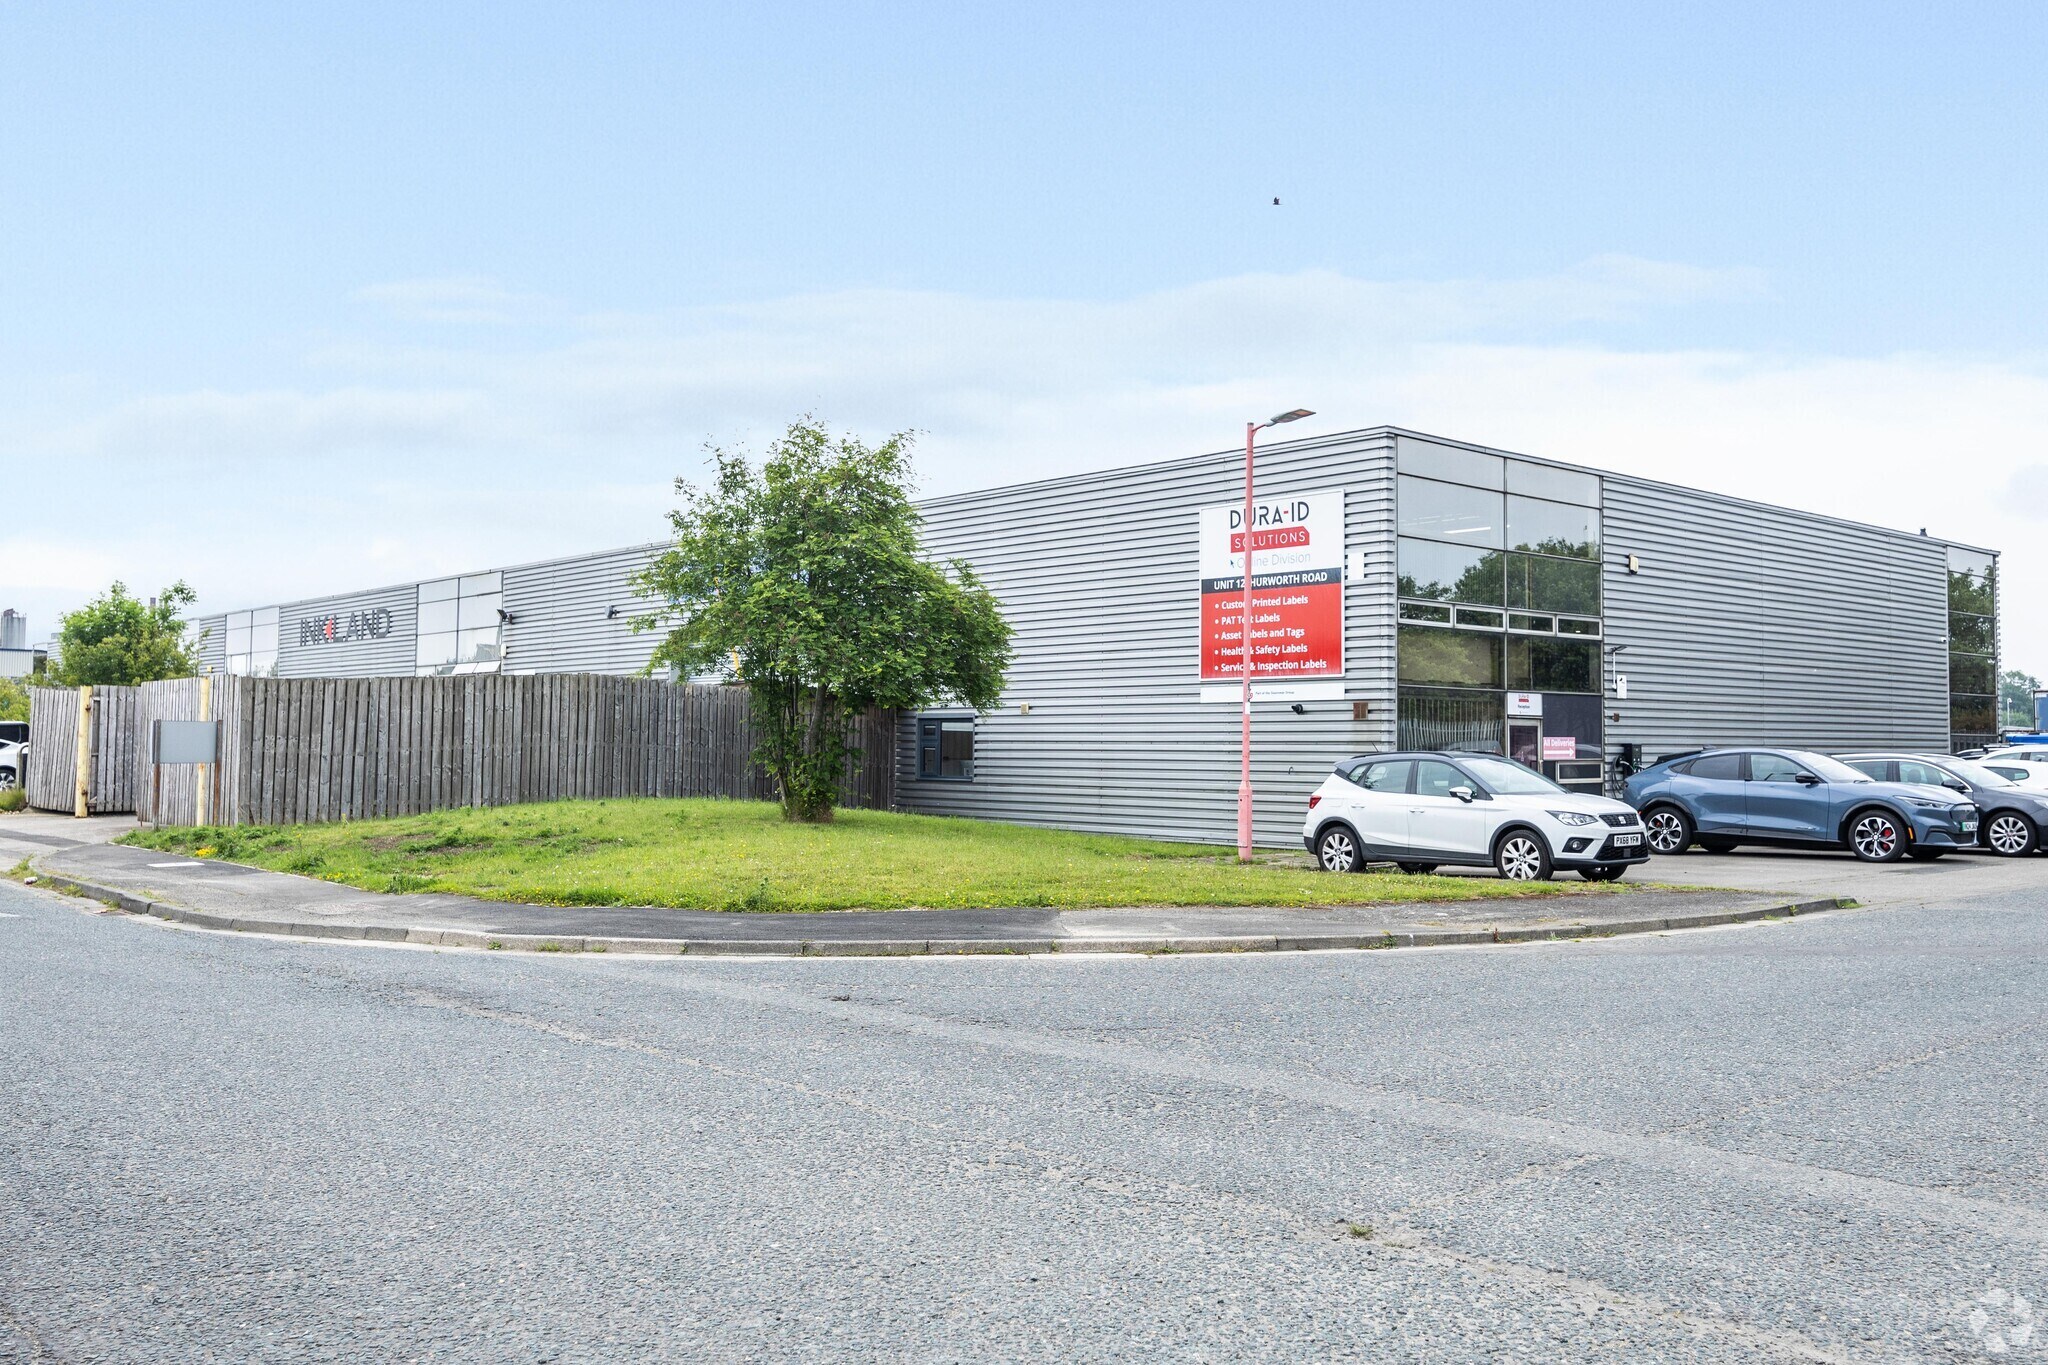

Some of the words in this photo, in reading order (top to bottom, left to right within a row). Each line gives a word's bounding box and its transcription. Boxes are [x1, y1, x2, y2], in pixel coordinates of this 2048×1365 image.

[1230, 501, 1309, 529] DURA-ID
[1237, 556, 1268, 568] Oine
[1271, 553, 1311, 566] Division
[1214, 580, 1234, 590] UNIT
[1251, 574, 1300, 588] HURWORTH
[1302, 572, 1328, 583] ROAD
[1221, 600, 1247, 610] Custo
[1252, 597, 1281, 608] Printed
[1282, 595, 1309, 606] Labels
[1221, 616, 1236, 625] PAT
[1237, 614, 1253, 625] Tet
[1255, 613, 1280, 624] Labels
[1221, 631, 1242, 640] Asset
[1246, 629, 1268, 639] bels
[1269, 628, 1284, 638] and
[1286, 628, 1305, 639] Tags
[1255, 644, 1280, 656] Safety
[1281, 643, 1308, 654] Labels
[1221, 662, 1247, 672] Servic
[1249, 662, 1256, 671] &
[1257, 659, 1299, 672] Inspection
[1300, 658, 1327, 669] Labels
[1551, 738, 1575, 747] Deliveries
